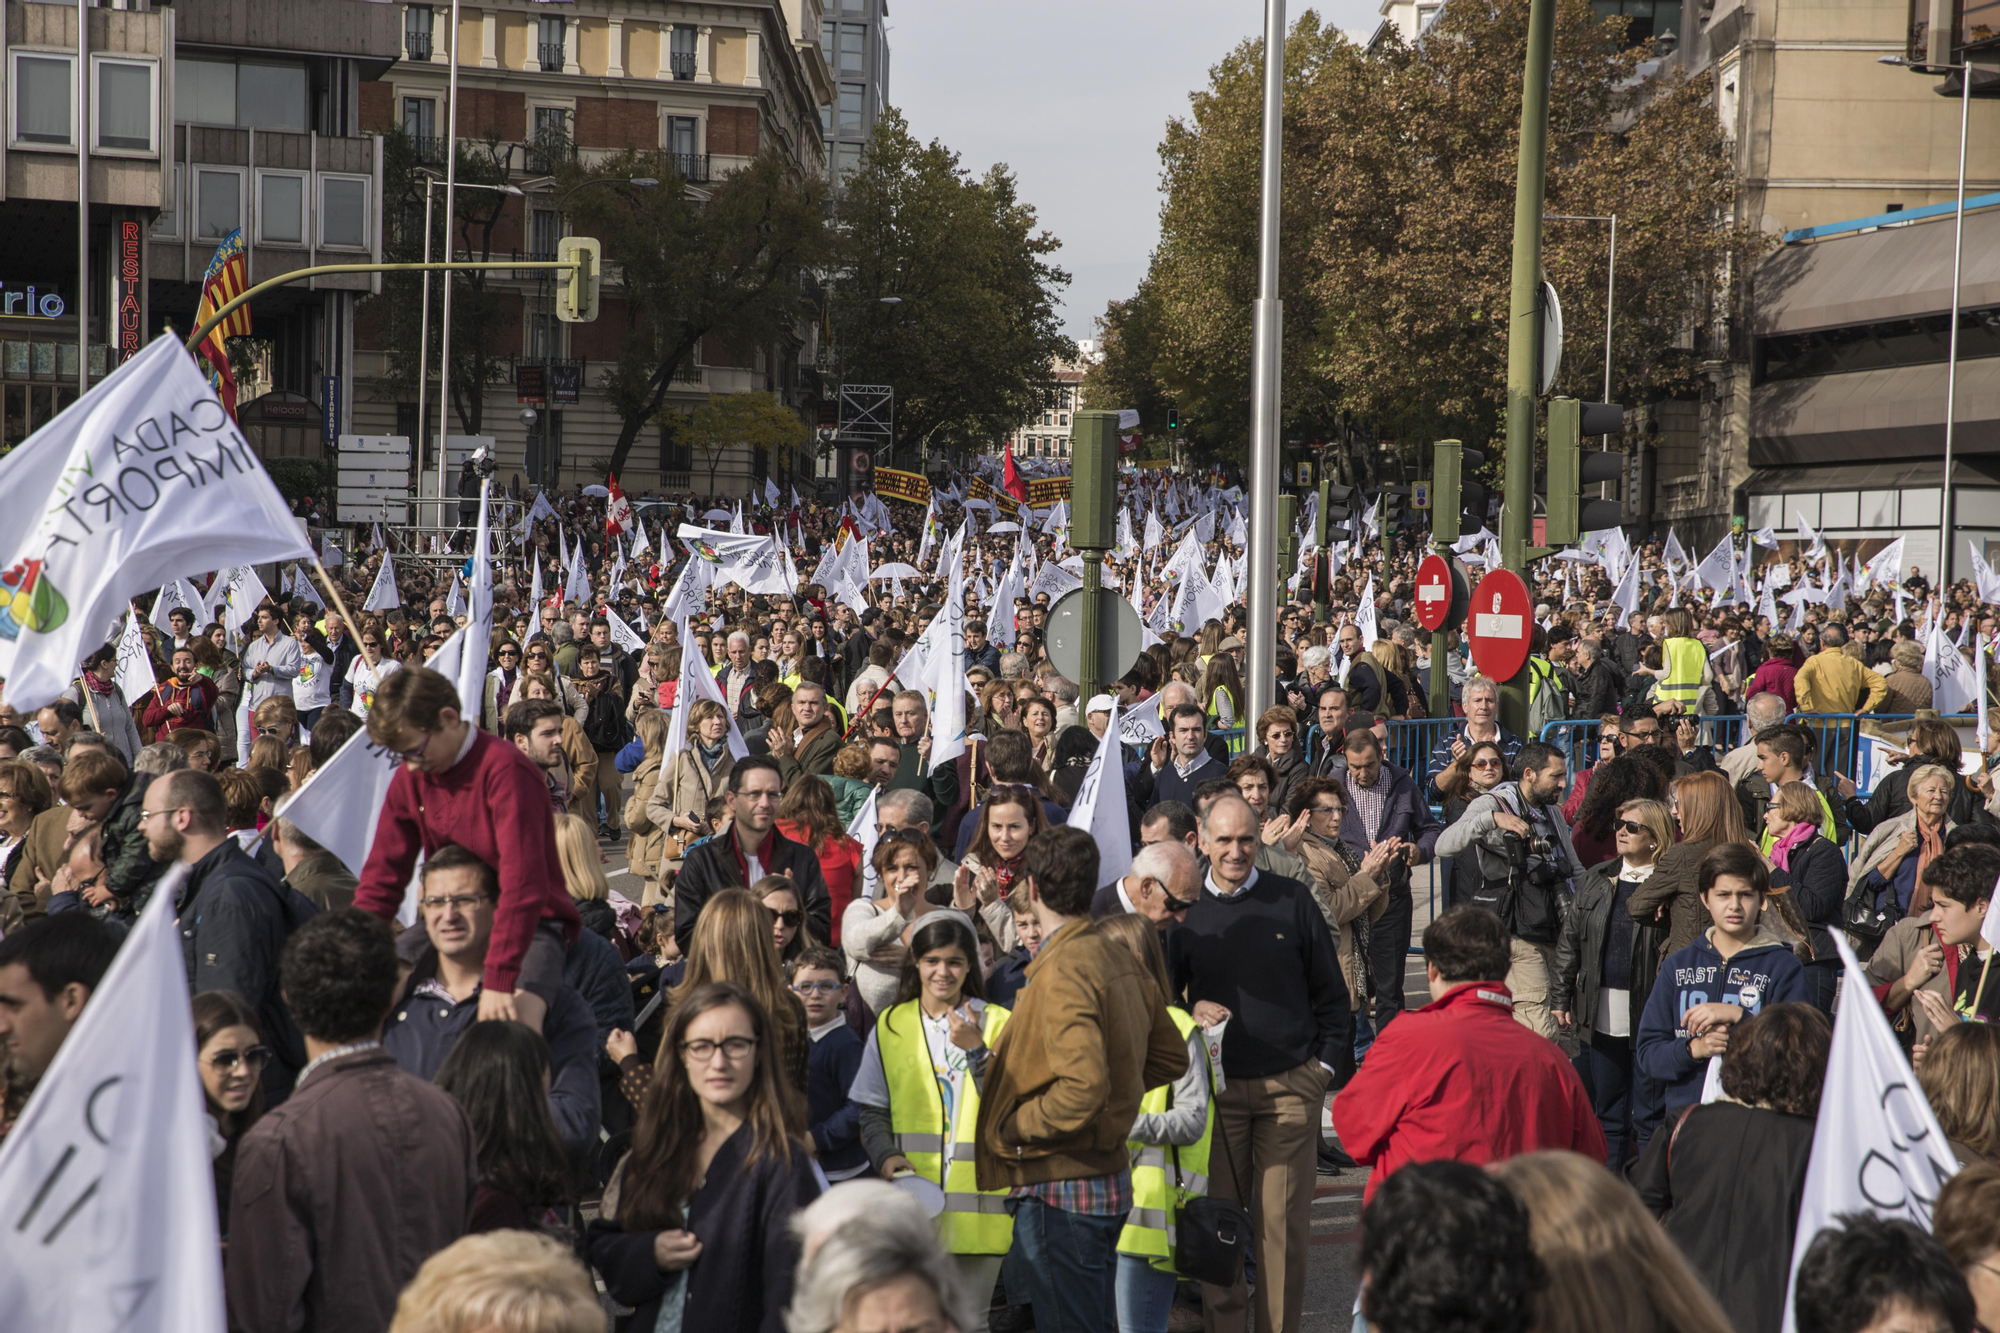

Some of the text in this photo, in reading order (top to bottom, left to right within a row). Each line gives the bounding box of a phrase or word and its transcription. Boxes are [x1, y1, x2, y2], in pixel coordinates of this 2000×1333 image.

[0, 281, 65, 317] rio
[265, 405, 305, 415] Helados
[1035, 483, 1056, 501] CADA
[1675, 966, 1717, 986] FAST
